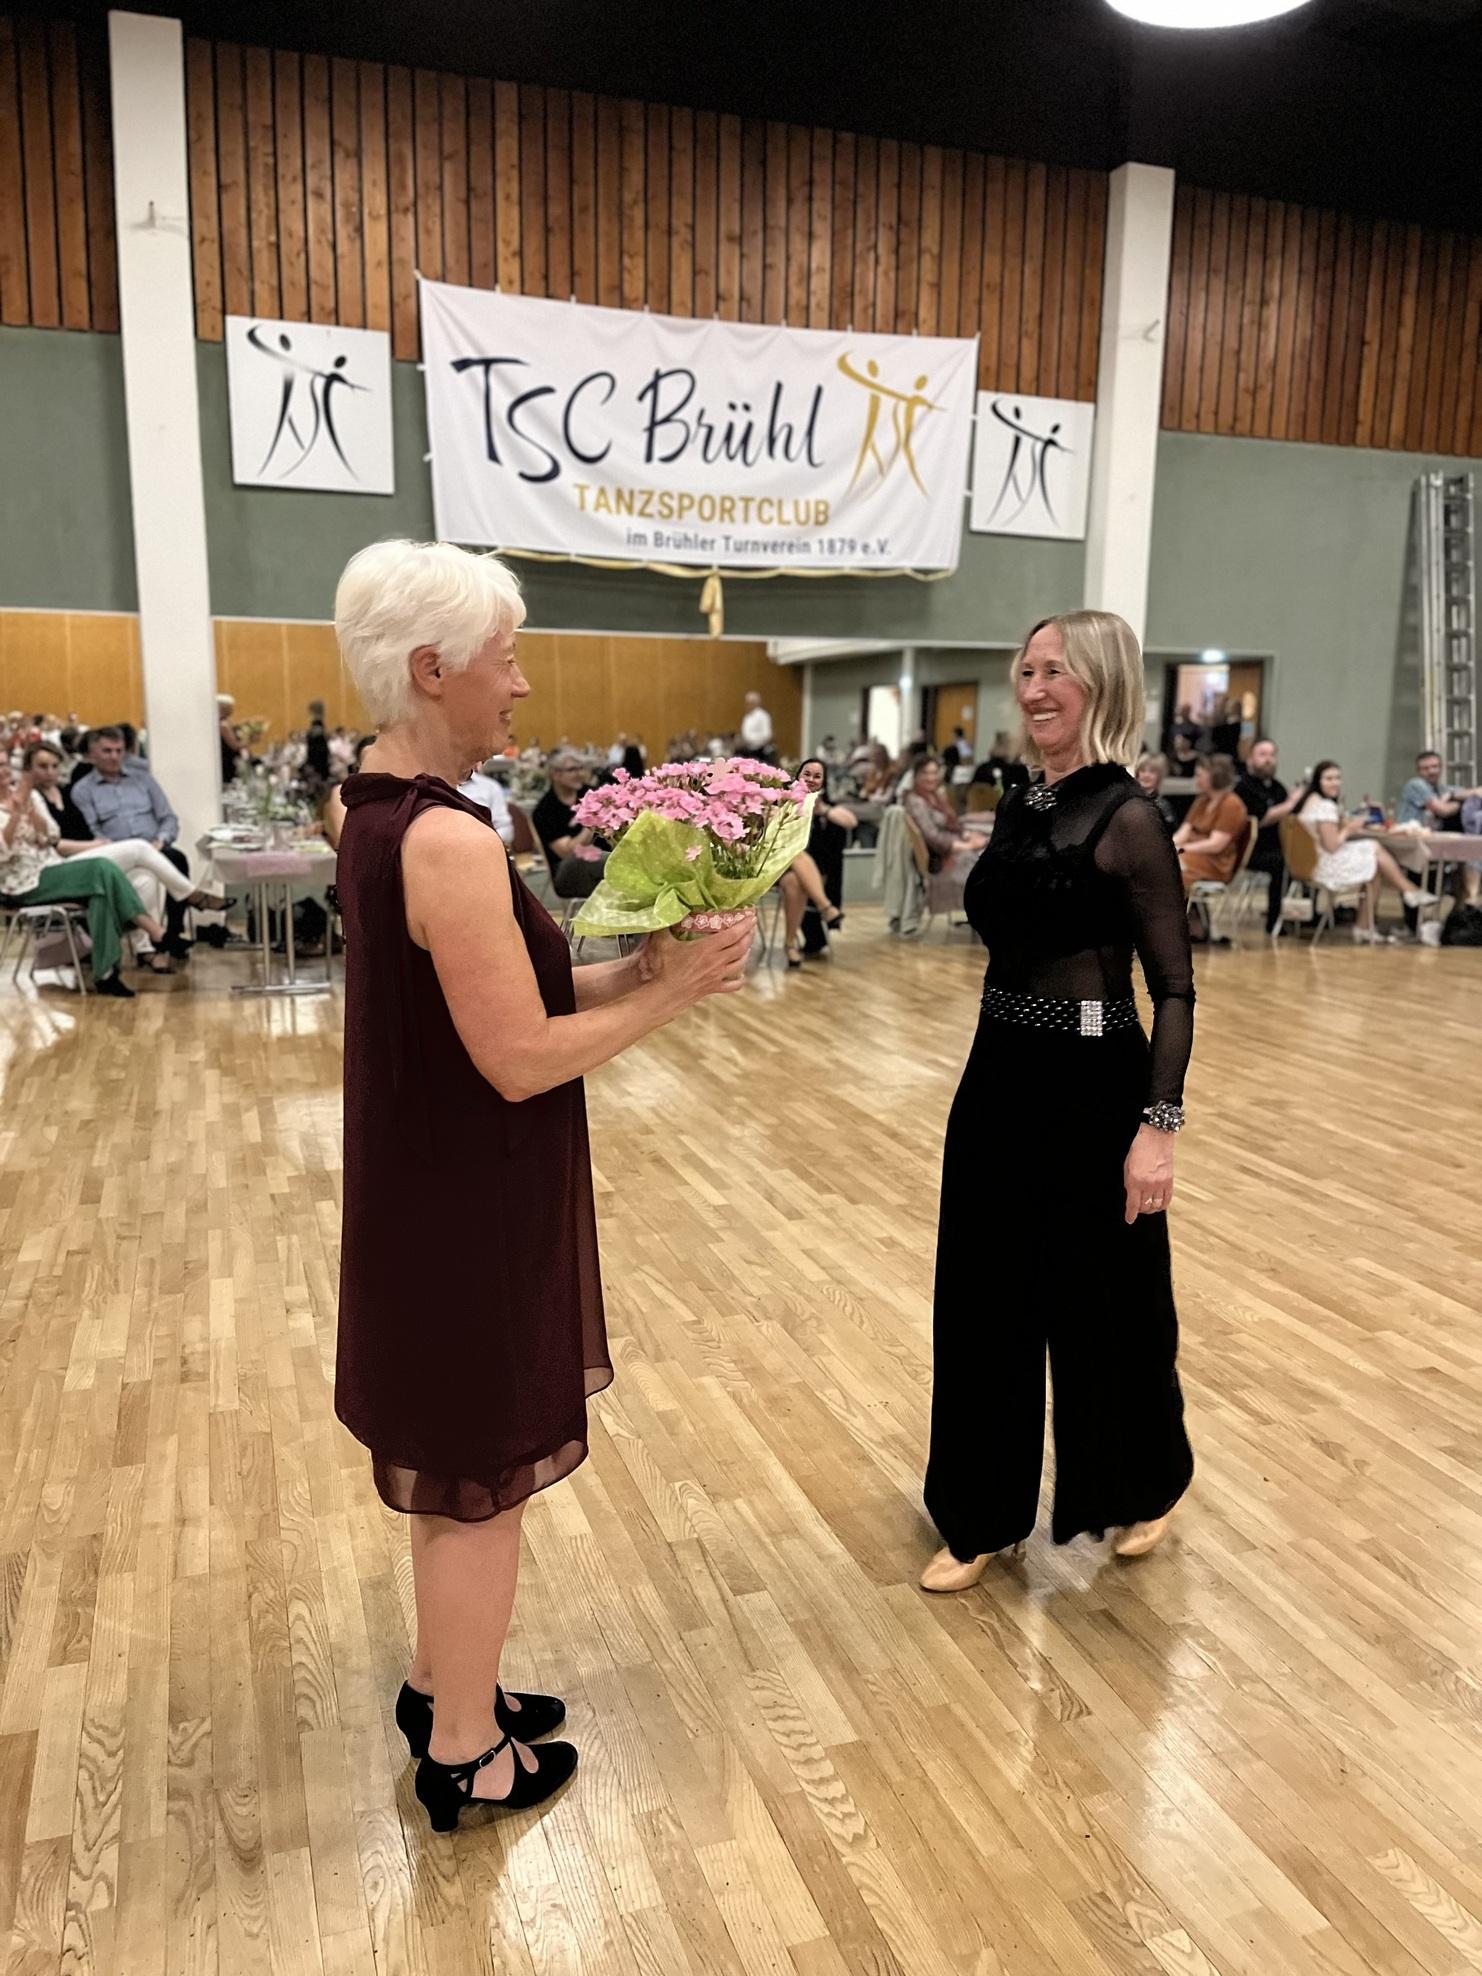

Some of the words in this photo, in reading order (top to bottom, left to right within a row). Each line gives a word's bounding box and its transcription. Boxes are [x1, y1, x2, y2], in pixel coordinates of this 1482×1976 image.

[450, 356, 617, 484] TSC
[636, 367, 824, 468] Brühl
[573, 483, 830, 527] TANZSPORTCLUB
[626, 527, 648, 547] im
[653, 530, 717, 549] Brühler
[722, 534, 811, 554] Turnverein
[817, 537, 857, 555] 1879
[860, 538, 892, 555] e.V.
